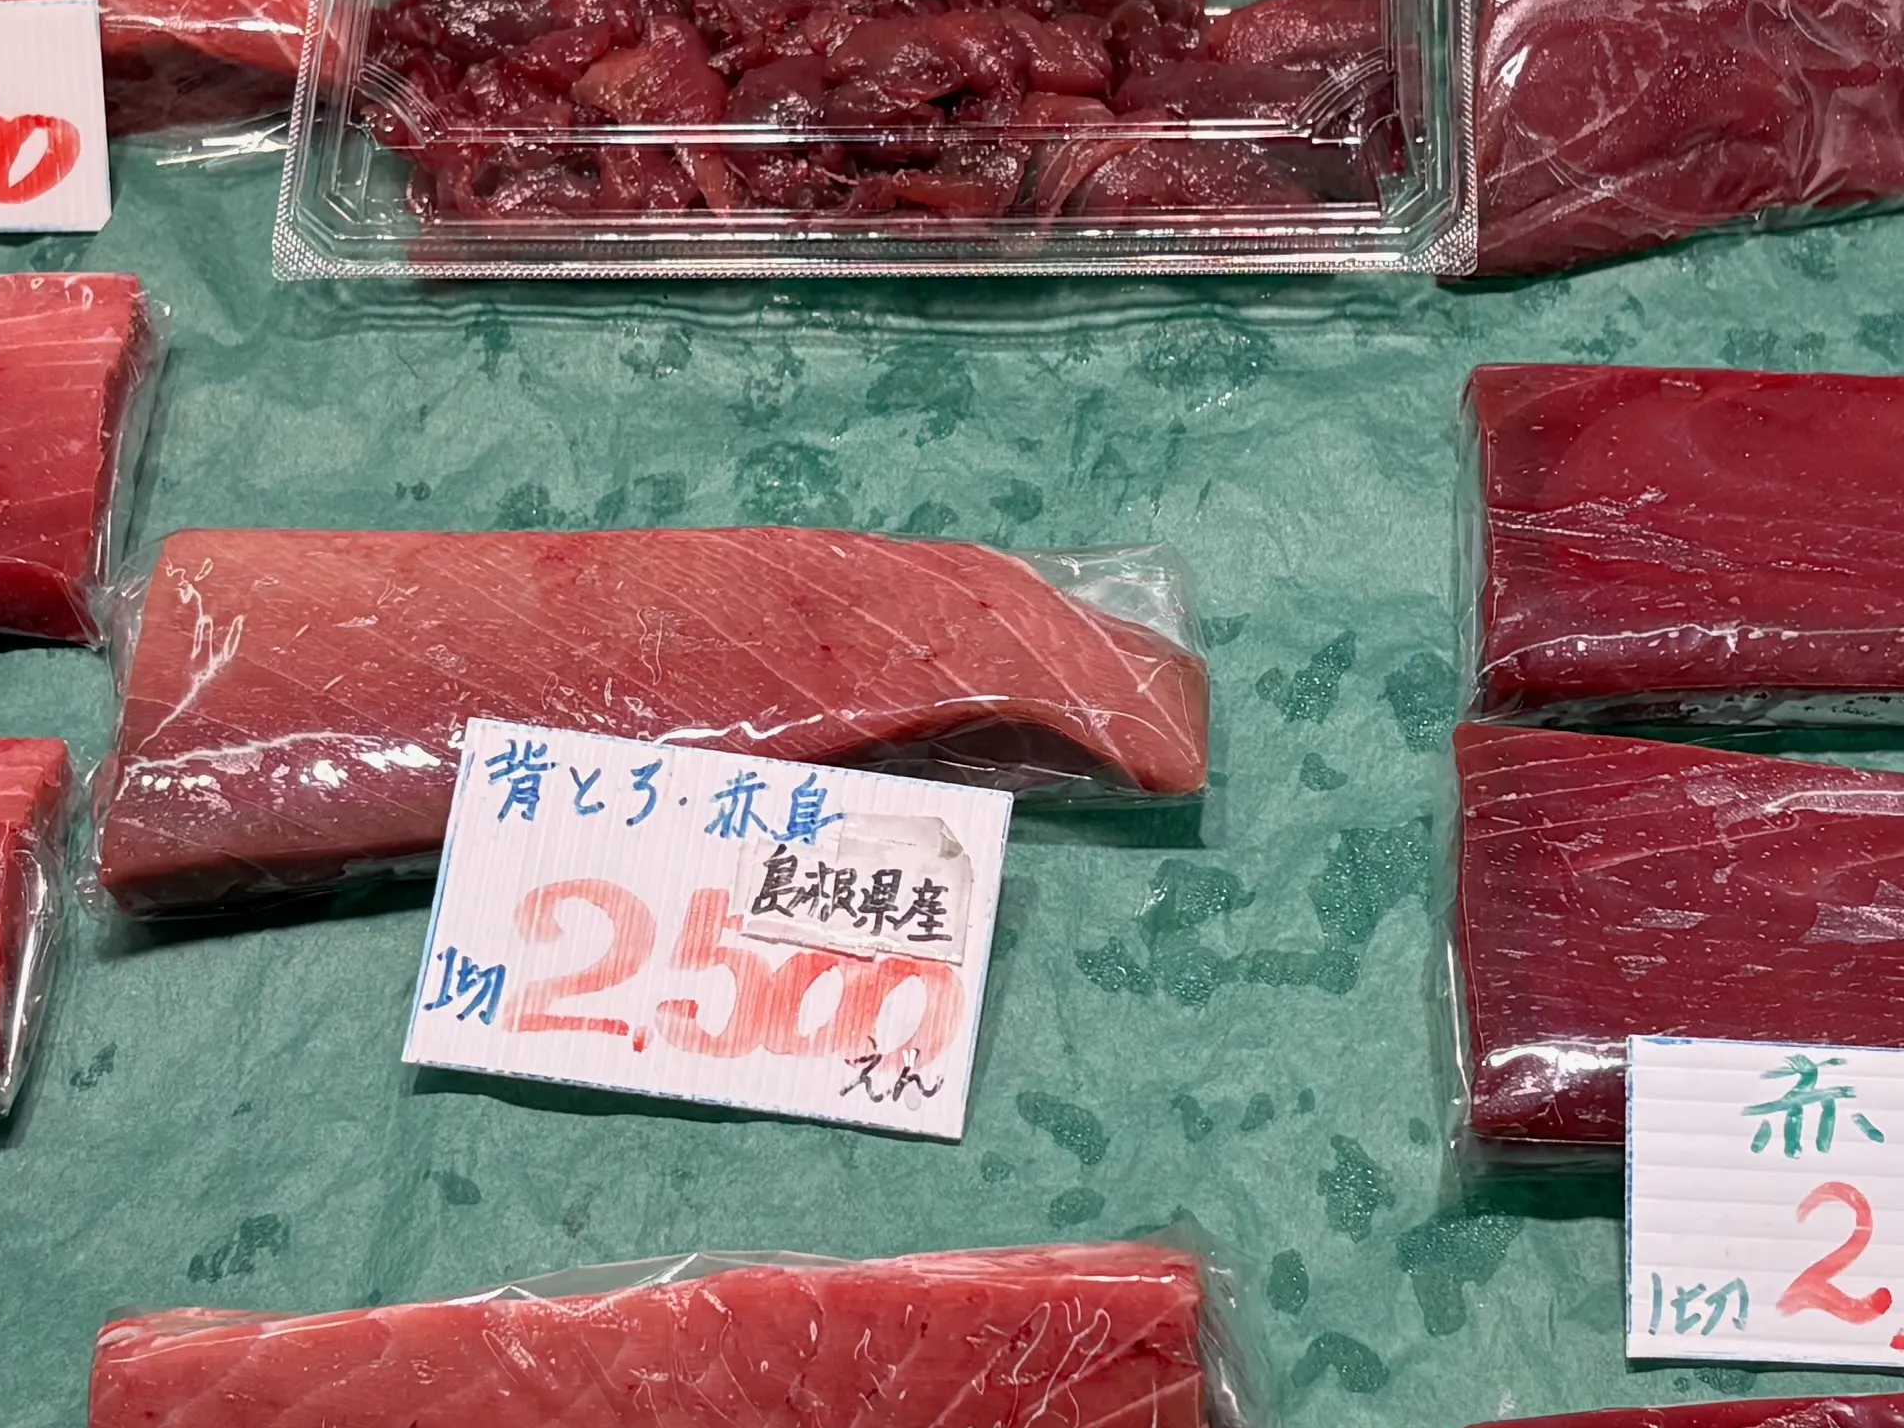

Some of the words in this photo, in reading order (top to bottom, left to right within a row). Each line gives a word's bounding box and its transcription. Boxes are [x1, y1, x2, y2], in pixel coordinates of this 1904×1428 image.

[748, 844, 953, 942] 島根県産
[839, 1037, 944, 1104] えん
